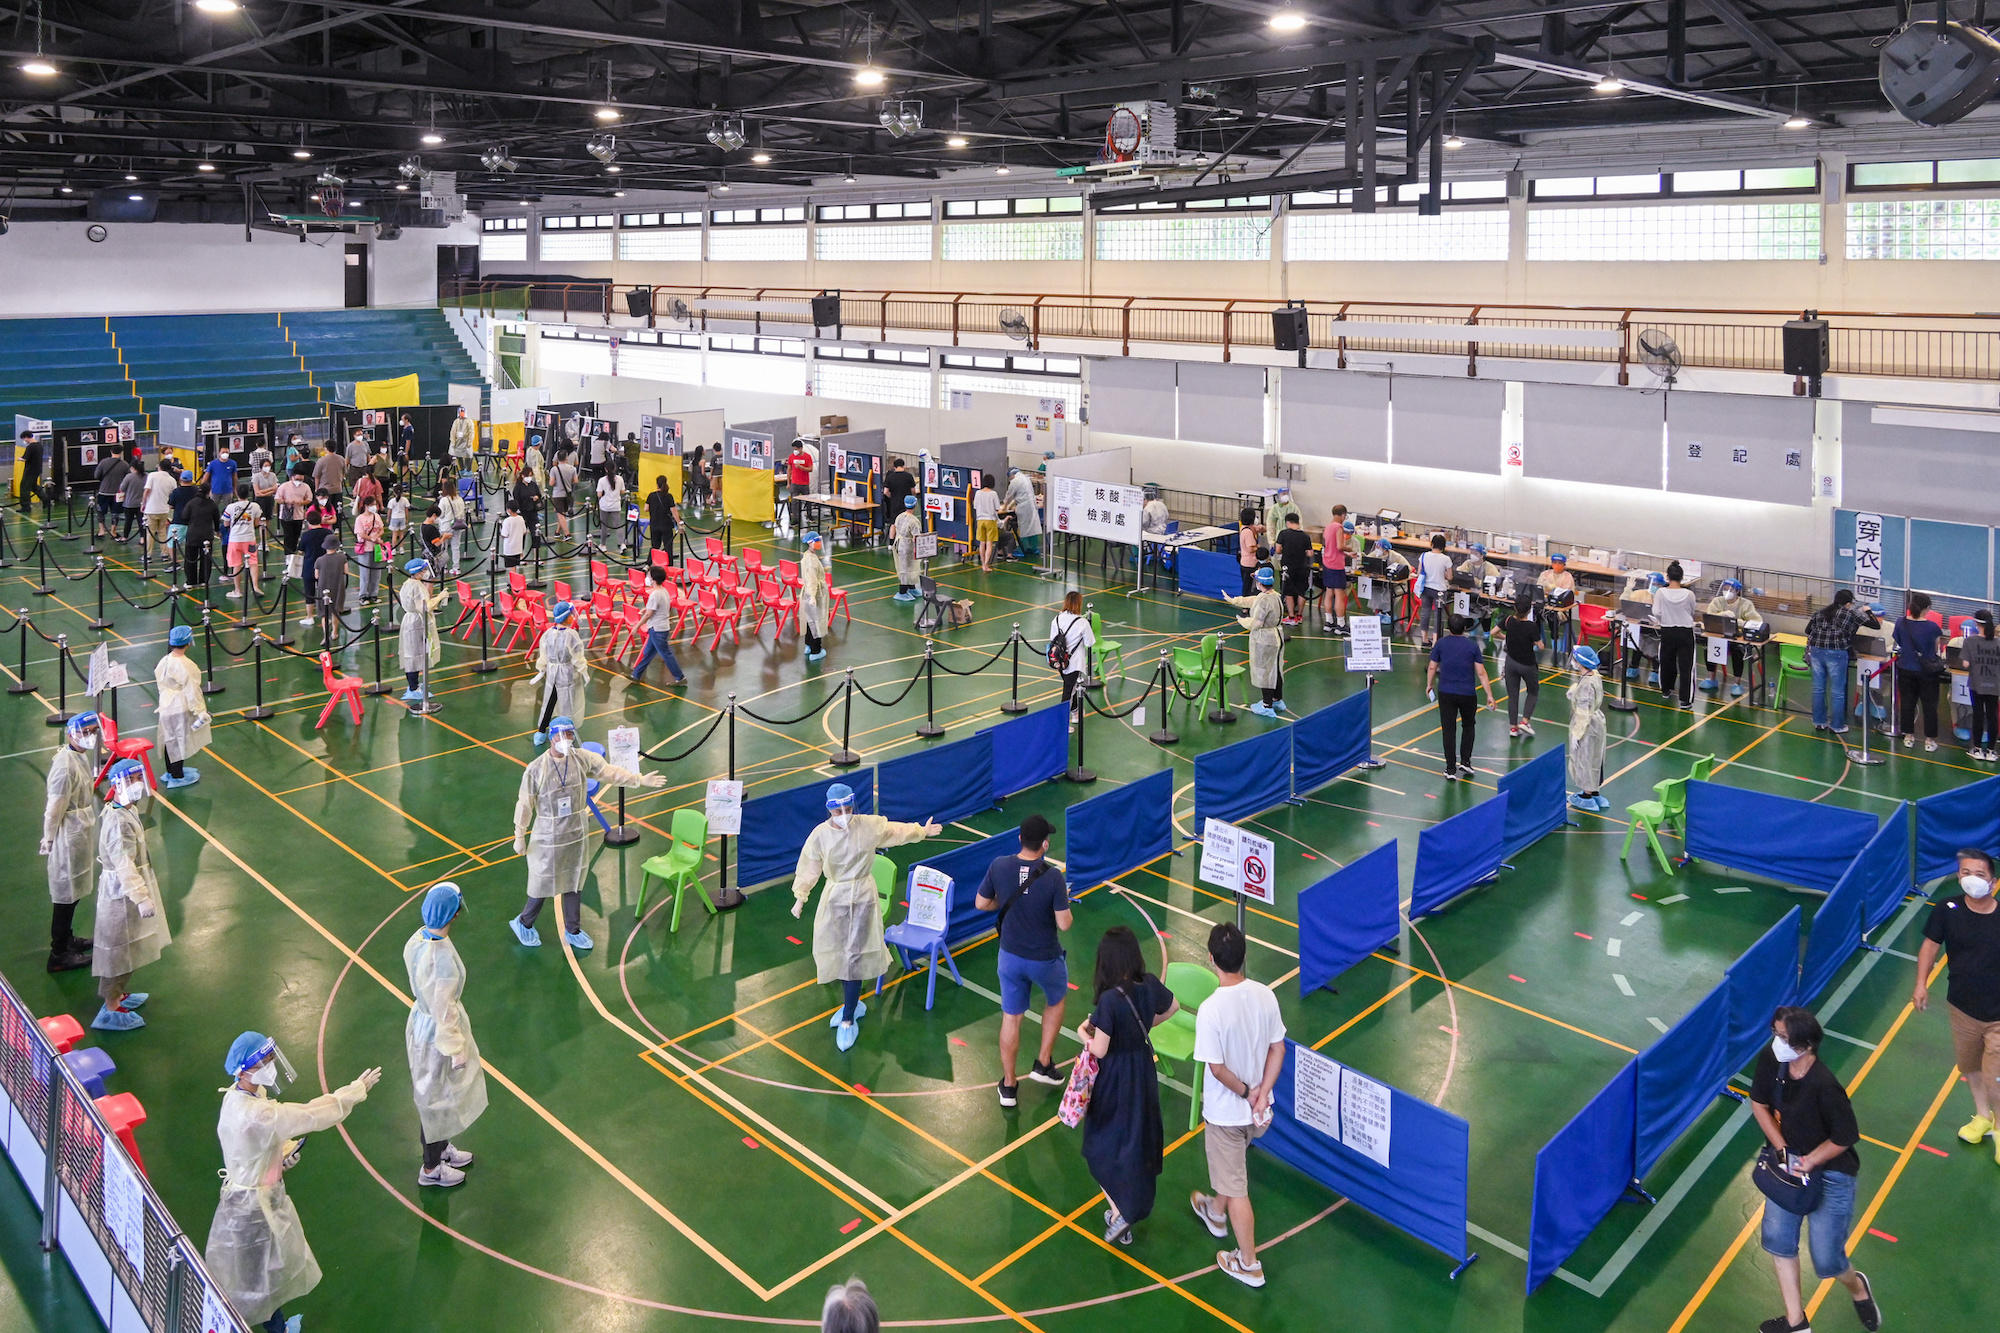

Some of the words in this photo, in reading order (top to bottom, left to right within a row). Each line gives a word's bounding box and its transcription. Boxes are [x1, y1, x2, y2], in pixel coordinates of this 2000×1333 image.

[248, 423, 255, 432] 8
[107, 433, 114, 442] 9
[764, 445, 770, 455] 3
[1688, 444, 1800, 467] 登記處
[752, 460, 763, 468] EXIT
[873, 462, 879, 472] 2
[973, 476, 978, 487] 1
[1095, 487, 1120, 504] 核酸
[1087, 508, 1125, 527] 檢測處
[1857, 520, 1880, 599] 穿衣區
[1361, 583, 1368, 593] 7
[1458, 599, 1465, 610] 6
[1713, 646, 1721, 658] 3
[1959, 684, 1968, 697] 1
[913, 898, 937, 912] Green
